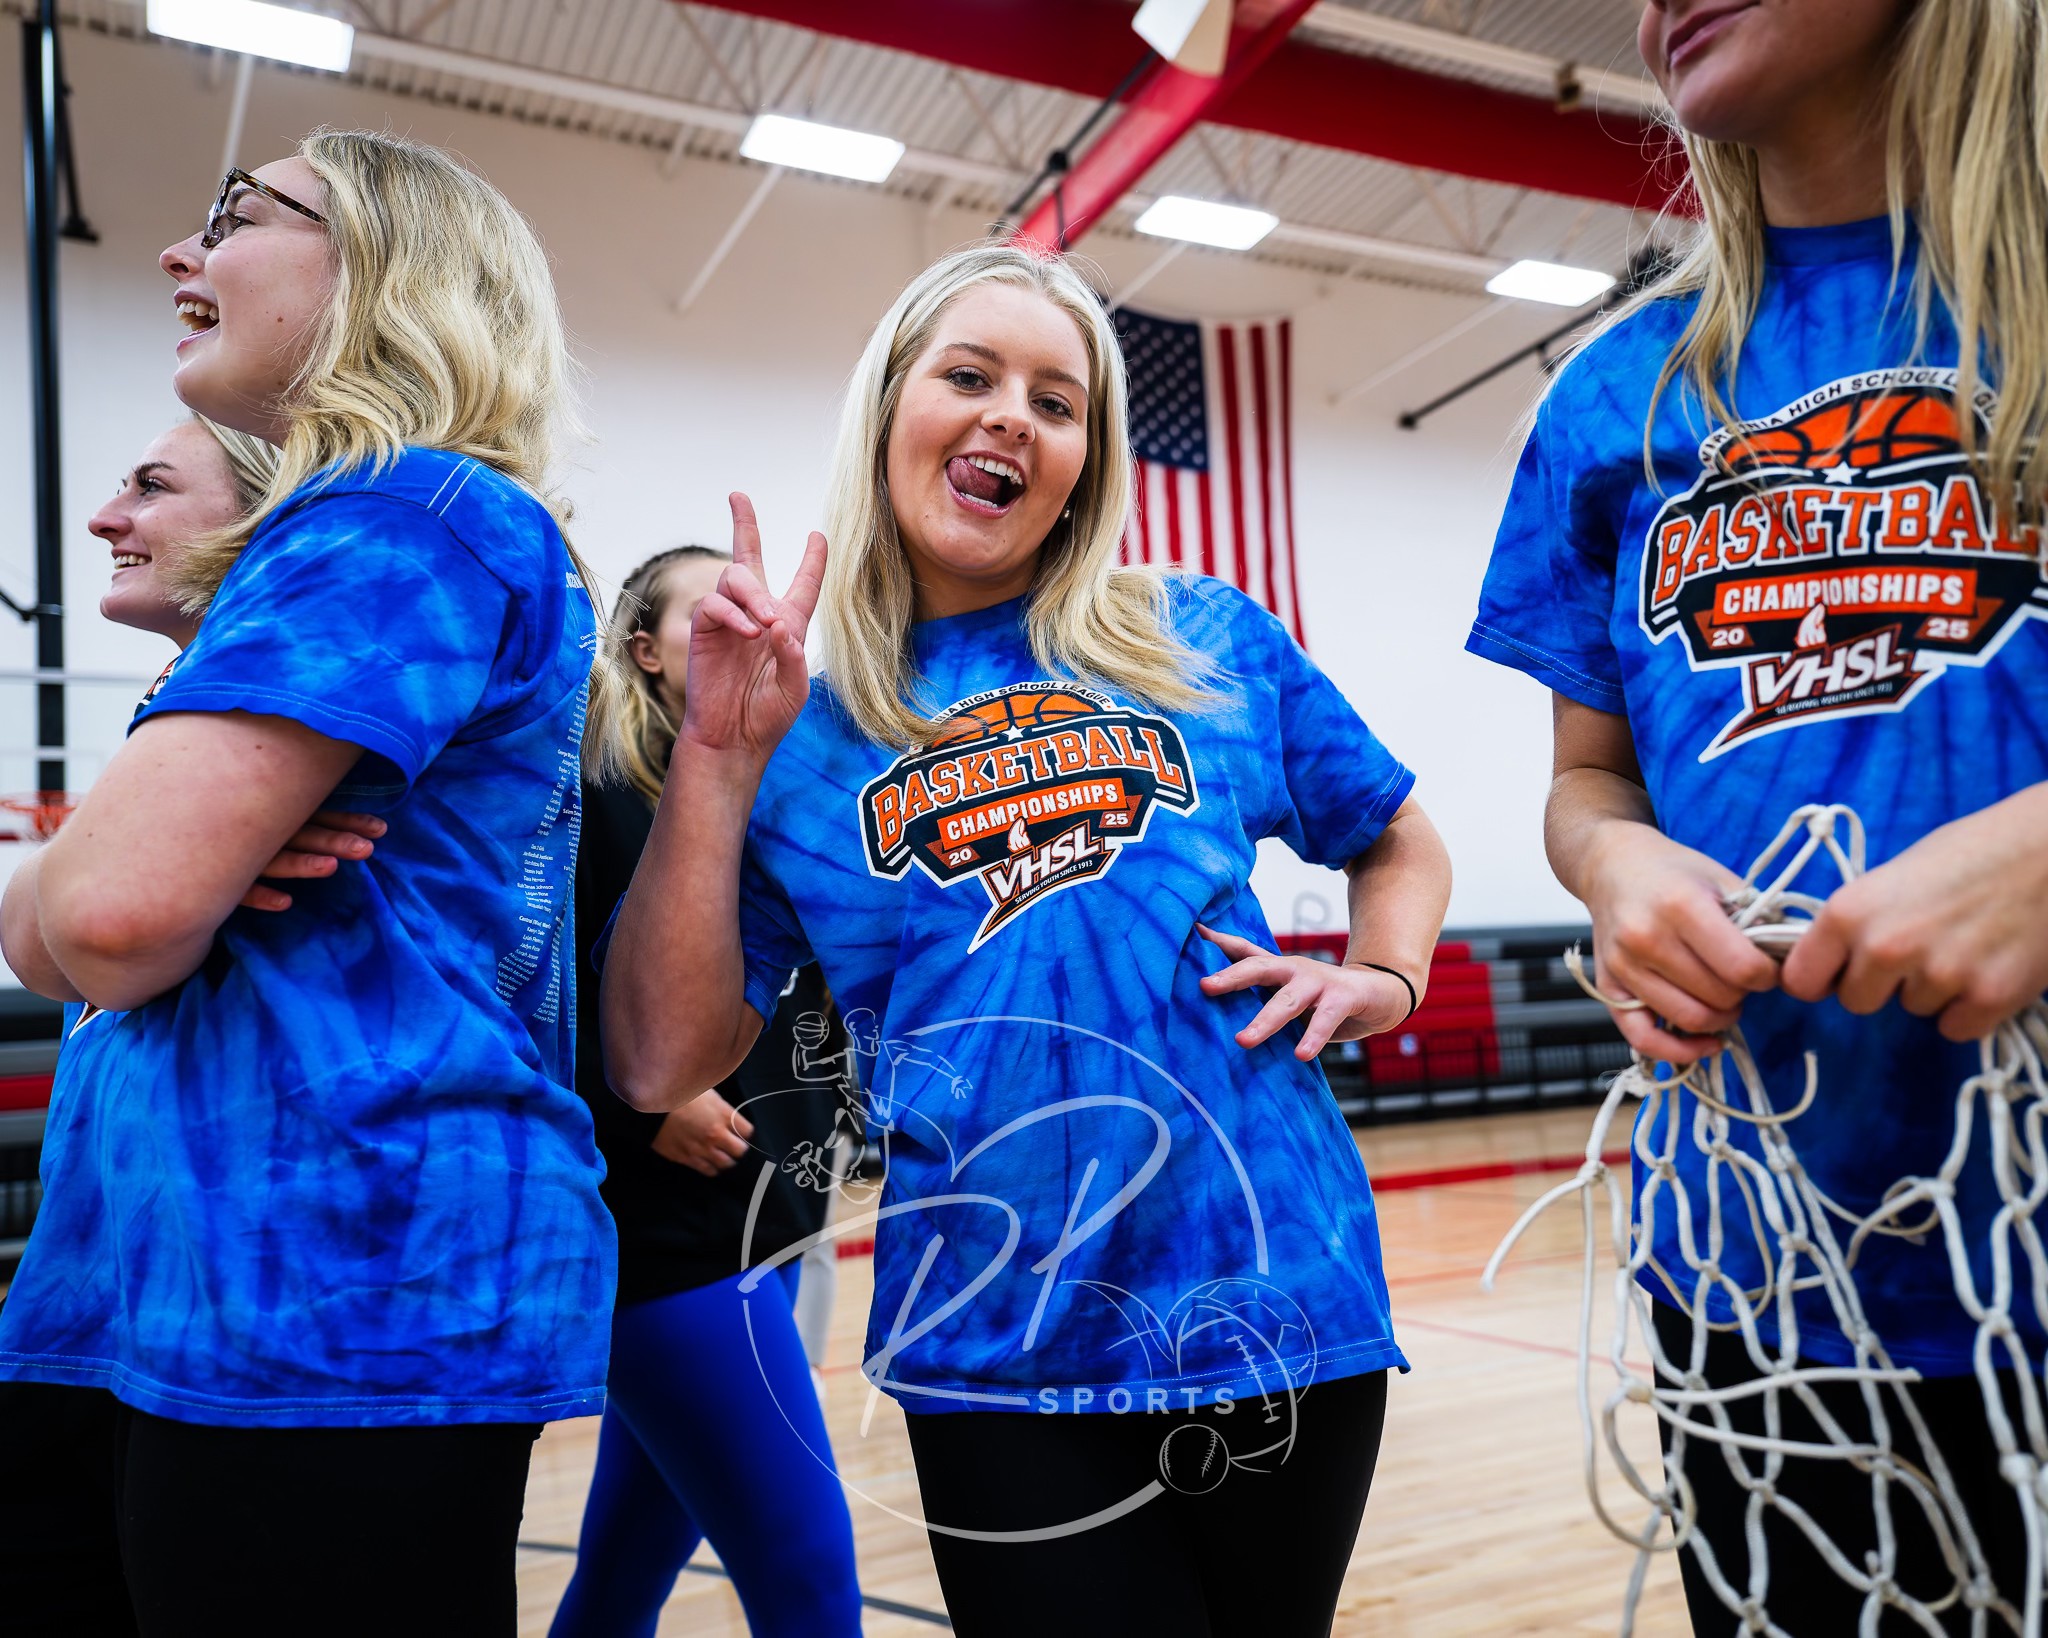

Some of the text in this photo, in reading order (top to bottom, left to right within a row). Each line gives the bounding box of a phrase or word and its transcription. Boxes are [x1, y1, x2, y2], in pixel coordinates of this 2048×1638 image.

[1702, 417, 1783, 462] VIRNIA
[1789, 383, 1842, 416] HIGH
[1851, 370, 1938, 391] SCHOOL
[1652, 475, 2048, 607] BASKETBAL
[1723, 575, 1964, 616] CHAMPIONSHIPS
[1711, 617, 1970, 647] 20 25
[958, 691, 995, 708] HIGH
[998, 681, 1058, 696] SCHOOL
[1062, 683, 1111, 706] LEAGUE
[1754, 631, 1906, 705] VHSL
[871, 724, 1186, 855] BASKETBALL
[946, 783, 1119, 842] CHAMPIONSHIPS
[948, 813, 1129, 866] 20 25
[990, 828, 1103, 900] VHSL
[1015, 859, 1093, 905] SERVING YOUTH SINCE 1913
